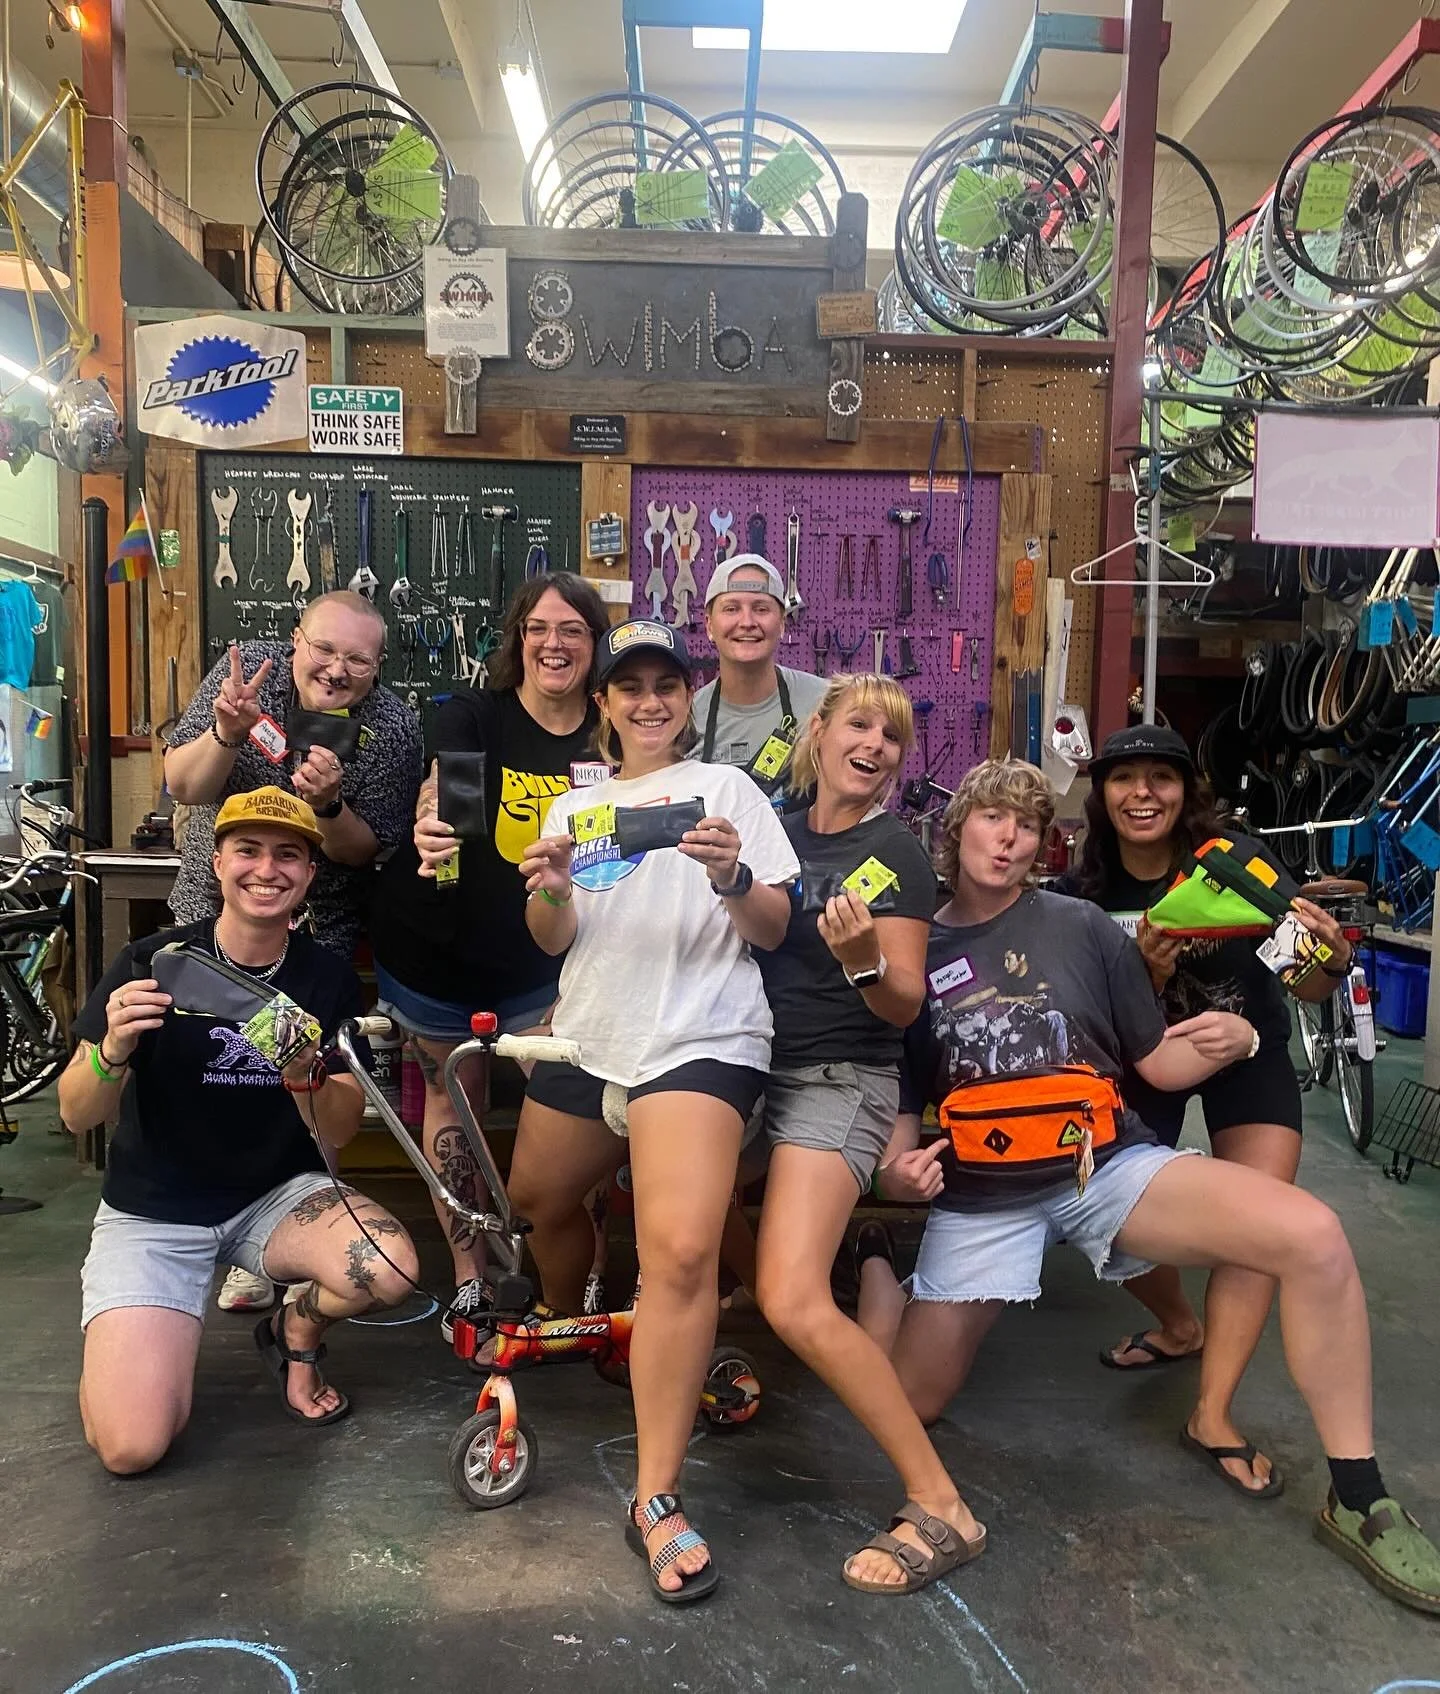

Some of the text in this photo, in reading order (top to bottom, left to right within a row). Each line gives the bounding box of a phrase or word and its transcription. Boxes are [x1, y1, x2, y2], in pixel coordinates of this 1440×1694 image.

[315, 390, 395, 407] SAFETY
[342, 402, 369, 411] FIRST
[312, 412, 401, 430] THINK SAFE
[312, 430, 401, 447] WORK SAFE
[575, 767, 603, 783] NIKKI
[501, 766, 569, 803] BUILT
[242, 795, 301, 815] BARBARIAN
[255, 807, 292, 818] BREWING
[202, 1071, 237, 1086] IGUANA
[239, 1072, 265, 1086] DEATH
[548, 1323, 609, 1337] Micro
